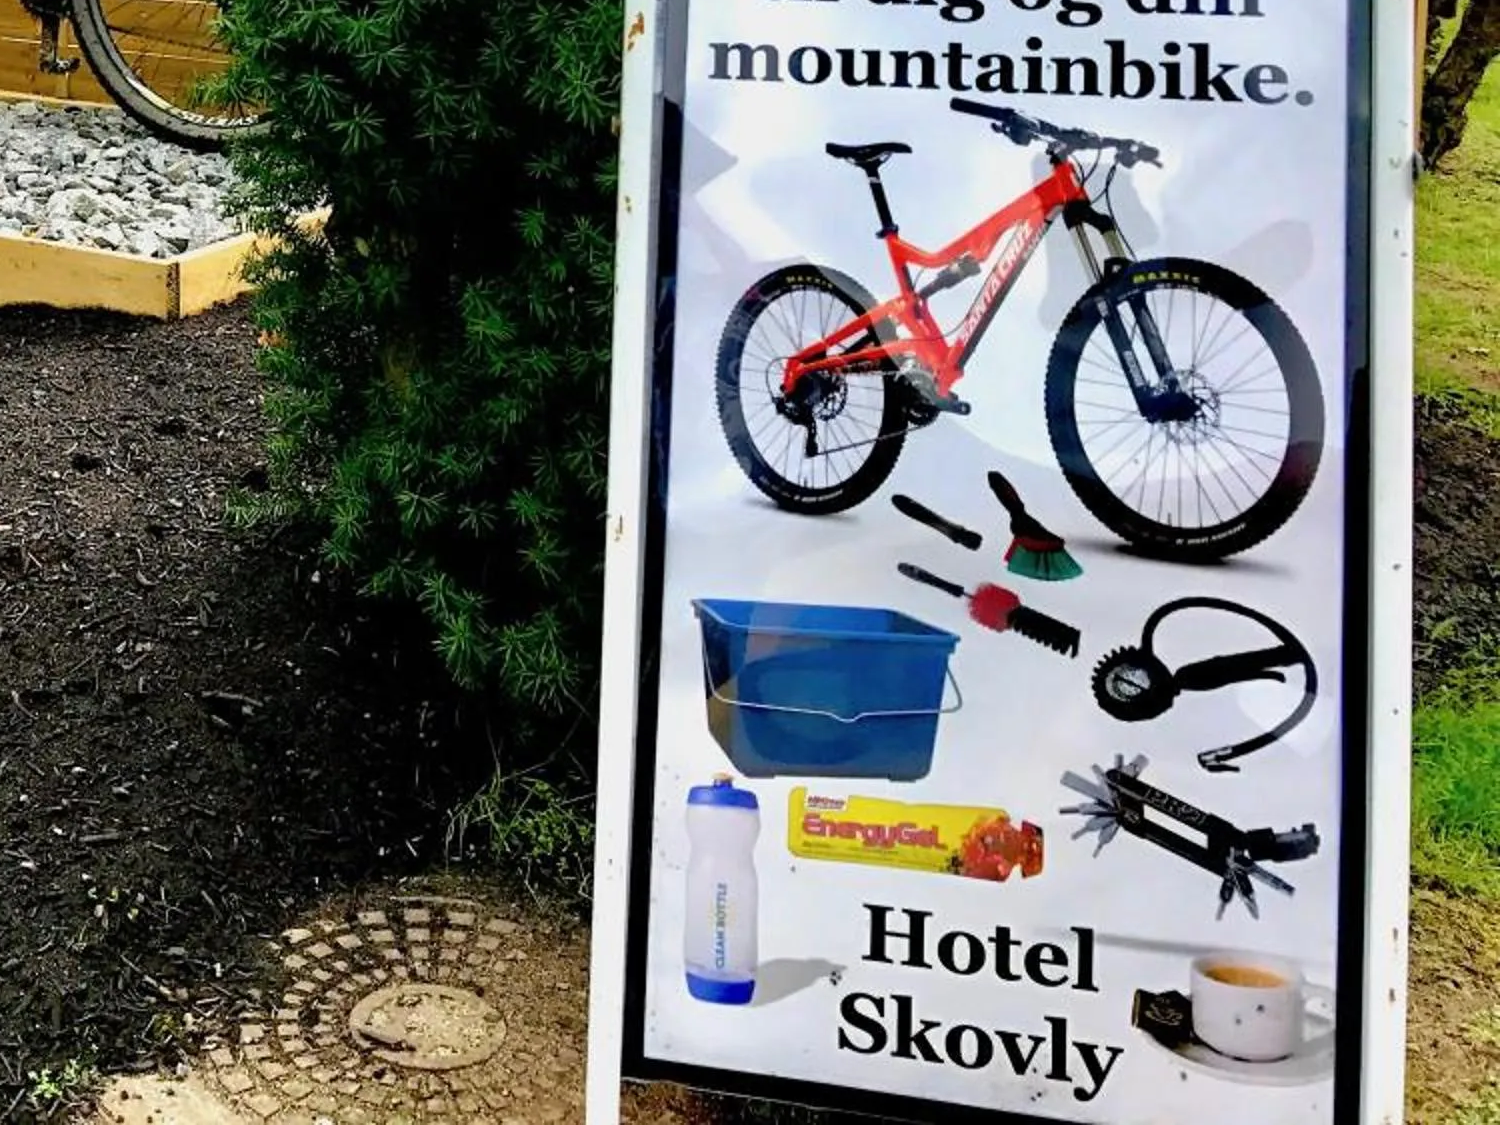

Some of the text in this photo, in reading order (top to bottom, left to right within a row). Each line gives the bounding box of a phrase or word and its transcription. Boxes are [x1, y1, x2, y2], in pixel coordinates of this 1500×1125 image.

[708, 37, 1314, 106] mountainbike.
[715, 882, 727, 969] CLEAN BOTTLE
[861, 903, 1099, 993] Hotel
[838, 992, 1125, 1102] Skovly
